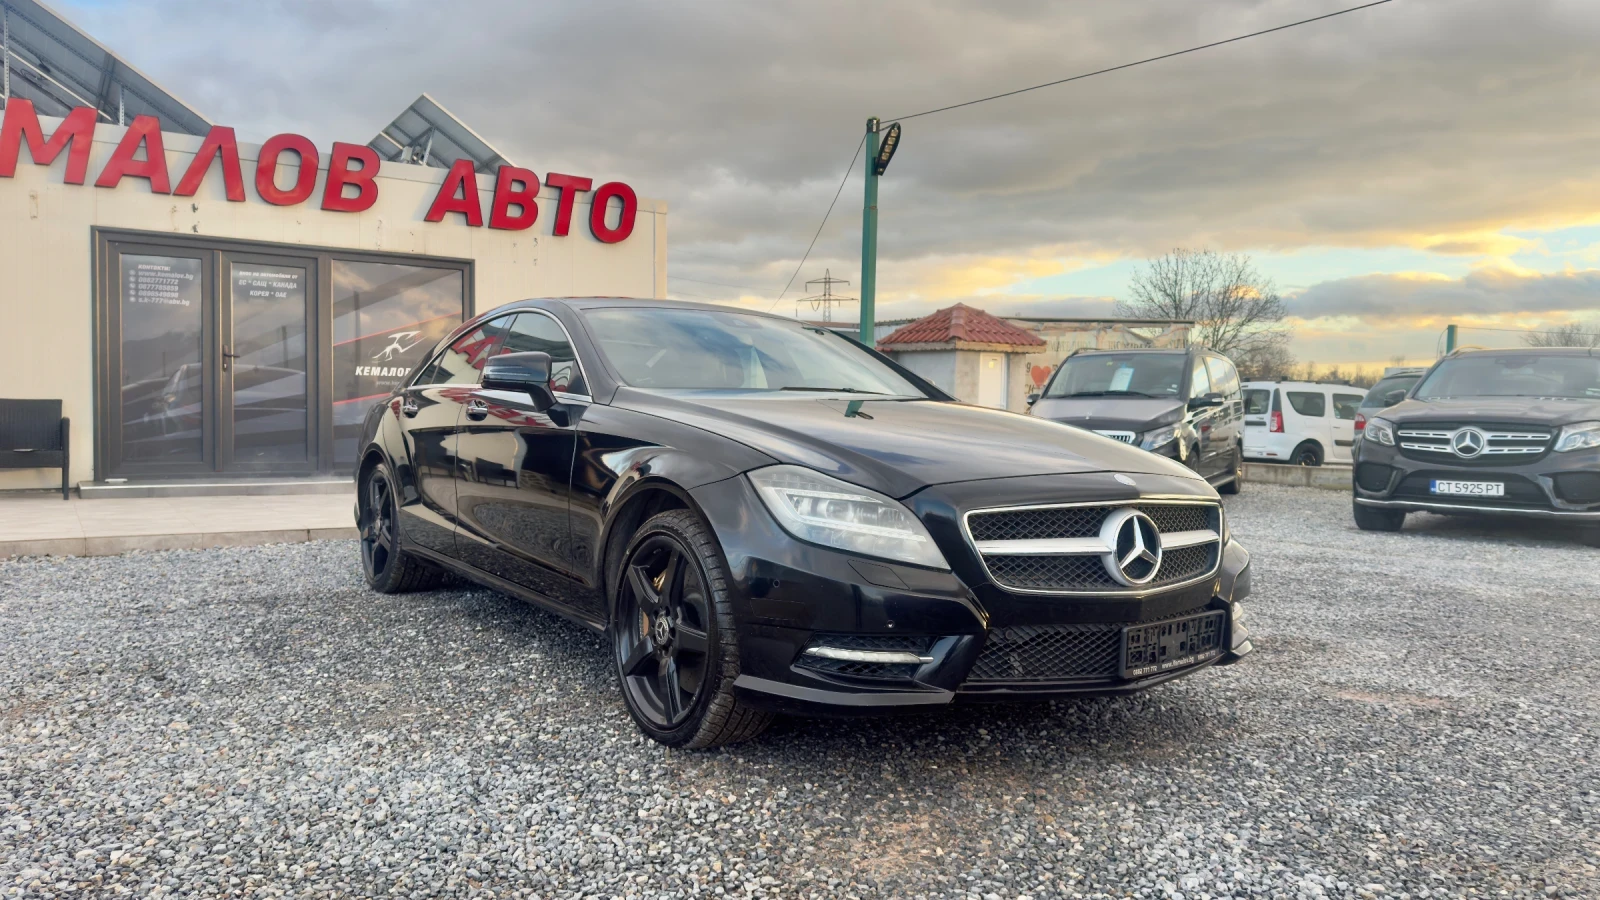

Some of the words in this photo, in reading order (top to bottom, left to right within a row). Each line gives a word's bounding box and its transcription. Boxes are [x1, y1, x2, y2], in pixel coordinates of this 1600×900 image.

[0, 96, 381, 213] МАЛОВ
[424, 158, 638, 244] АВТО
[1438, 482, 1452, 492] CT
[1455, 483, 1483, 494] 5925
[1486, 484, 1502, 494] PT
